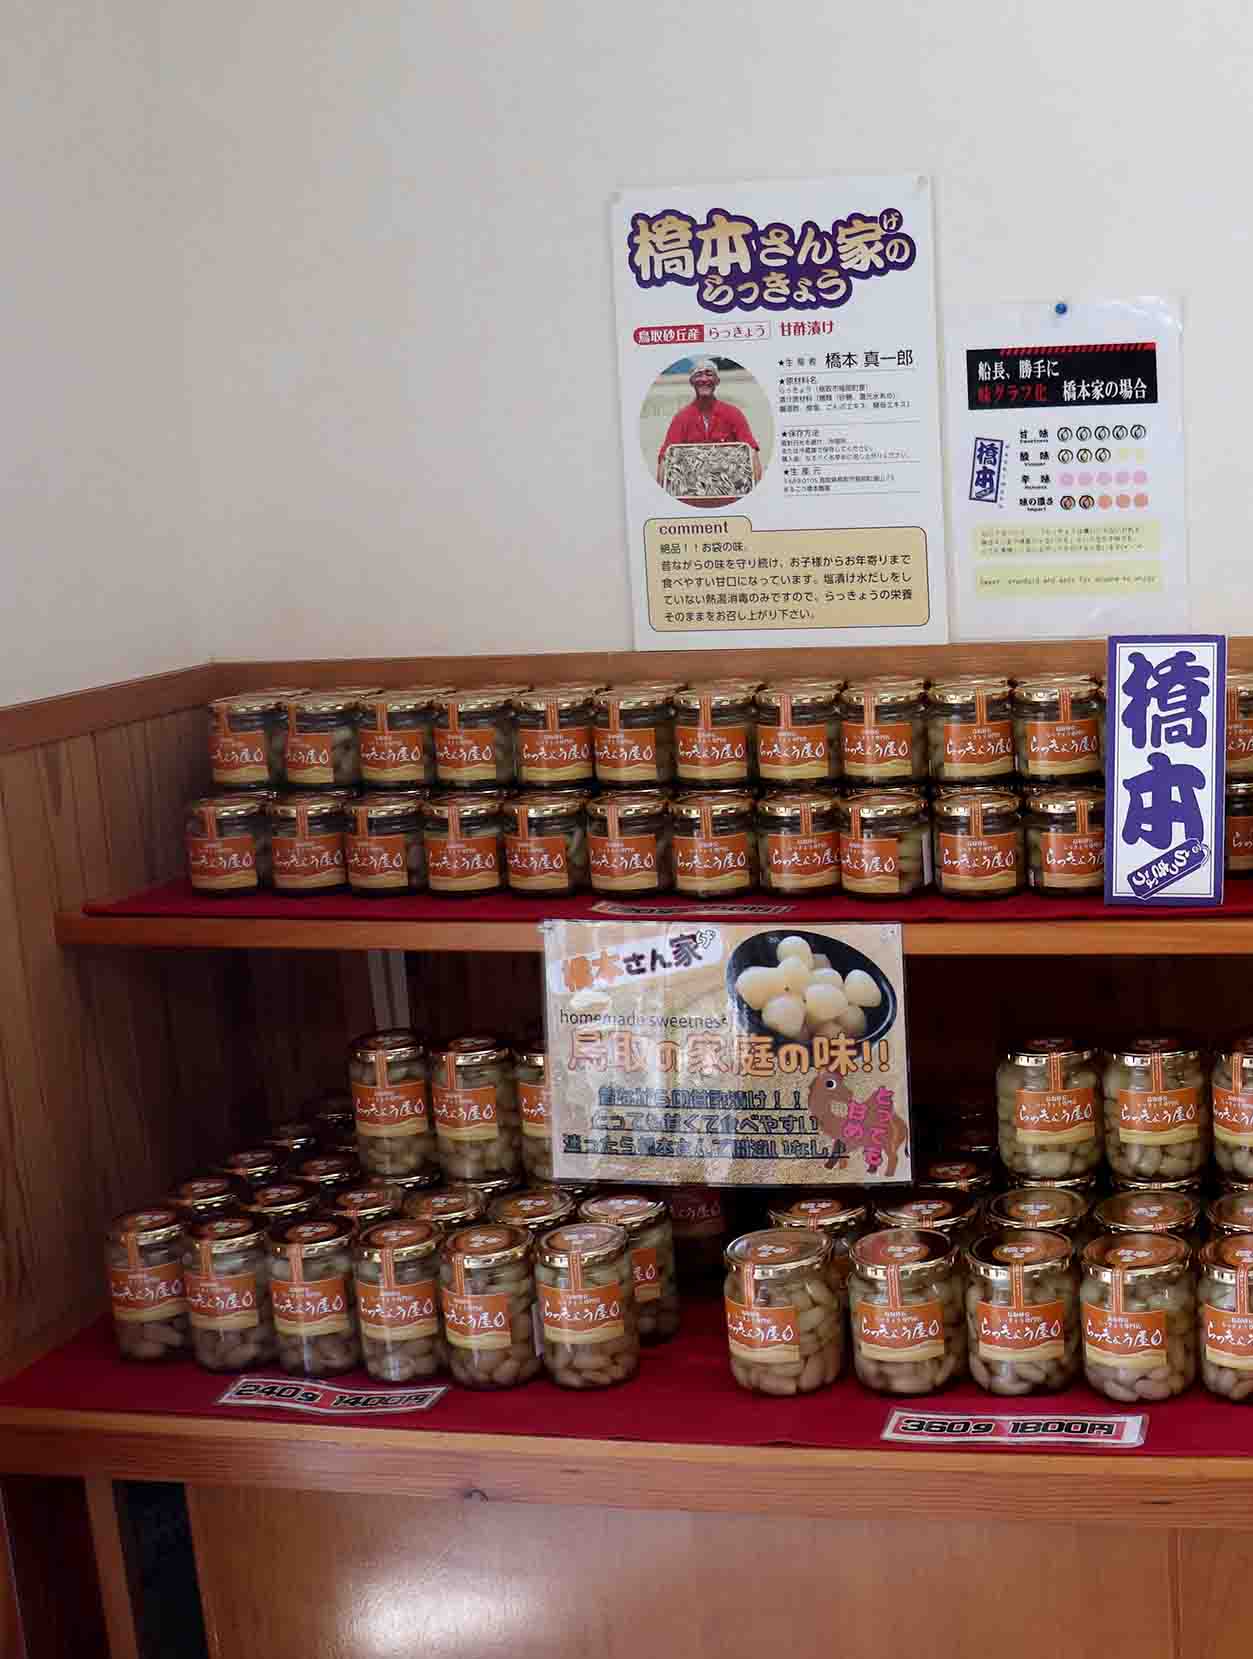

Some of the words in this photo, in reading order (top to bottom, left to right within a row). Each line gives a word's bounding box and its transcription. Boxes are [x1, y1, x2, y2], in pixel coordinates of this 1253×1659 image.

[630, 209, 913, 284] 橋本さん家の
[699, 267, 850, 309] らっきょう
[637, 327, 702, 343] 鳥取砂丘産
[708, 324, 766, 338] らっきょう
[779, 321, 834, 337] 甘酢漬け
[825, 352, 858, 368] 橋本
[864, 350, 913, 368] 真一郎
[978, 359, 1060, 382] 船長、勝手に
[1063, 377, 1148, 401] 橋本家の場合
[659, 521, 729, 535] comment
[1121, 651, 1209, 850] 橋本
[560, 1009, 647, 1027] homemad
[568, 1031, 892, 1077] 鳥取の家庭の味!!
[1121, 1102, 1186, 1125] らっきょう屋
[862, 1317, 931, 1340] らっきょう屋
[981, 1318, 1051, 1341] らっきょう屋
[1086, 1319, 1151, 1348] らっきょう屋
[237, 1383, 322, 1403] 240g
[902, 1419, 993, 1434] 360g
